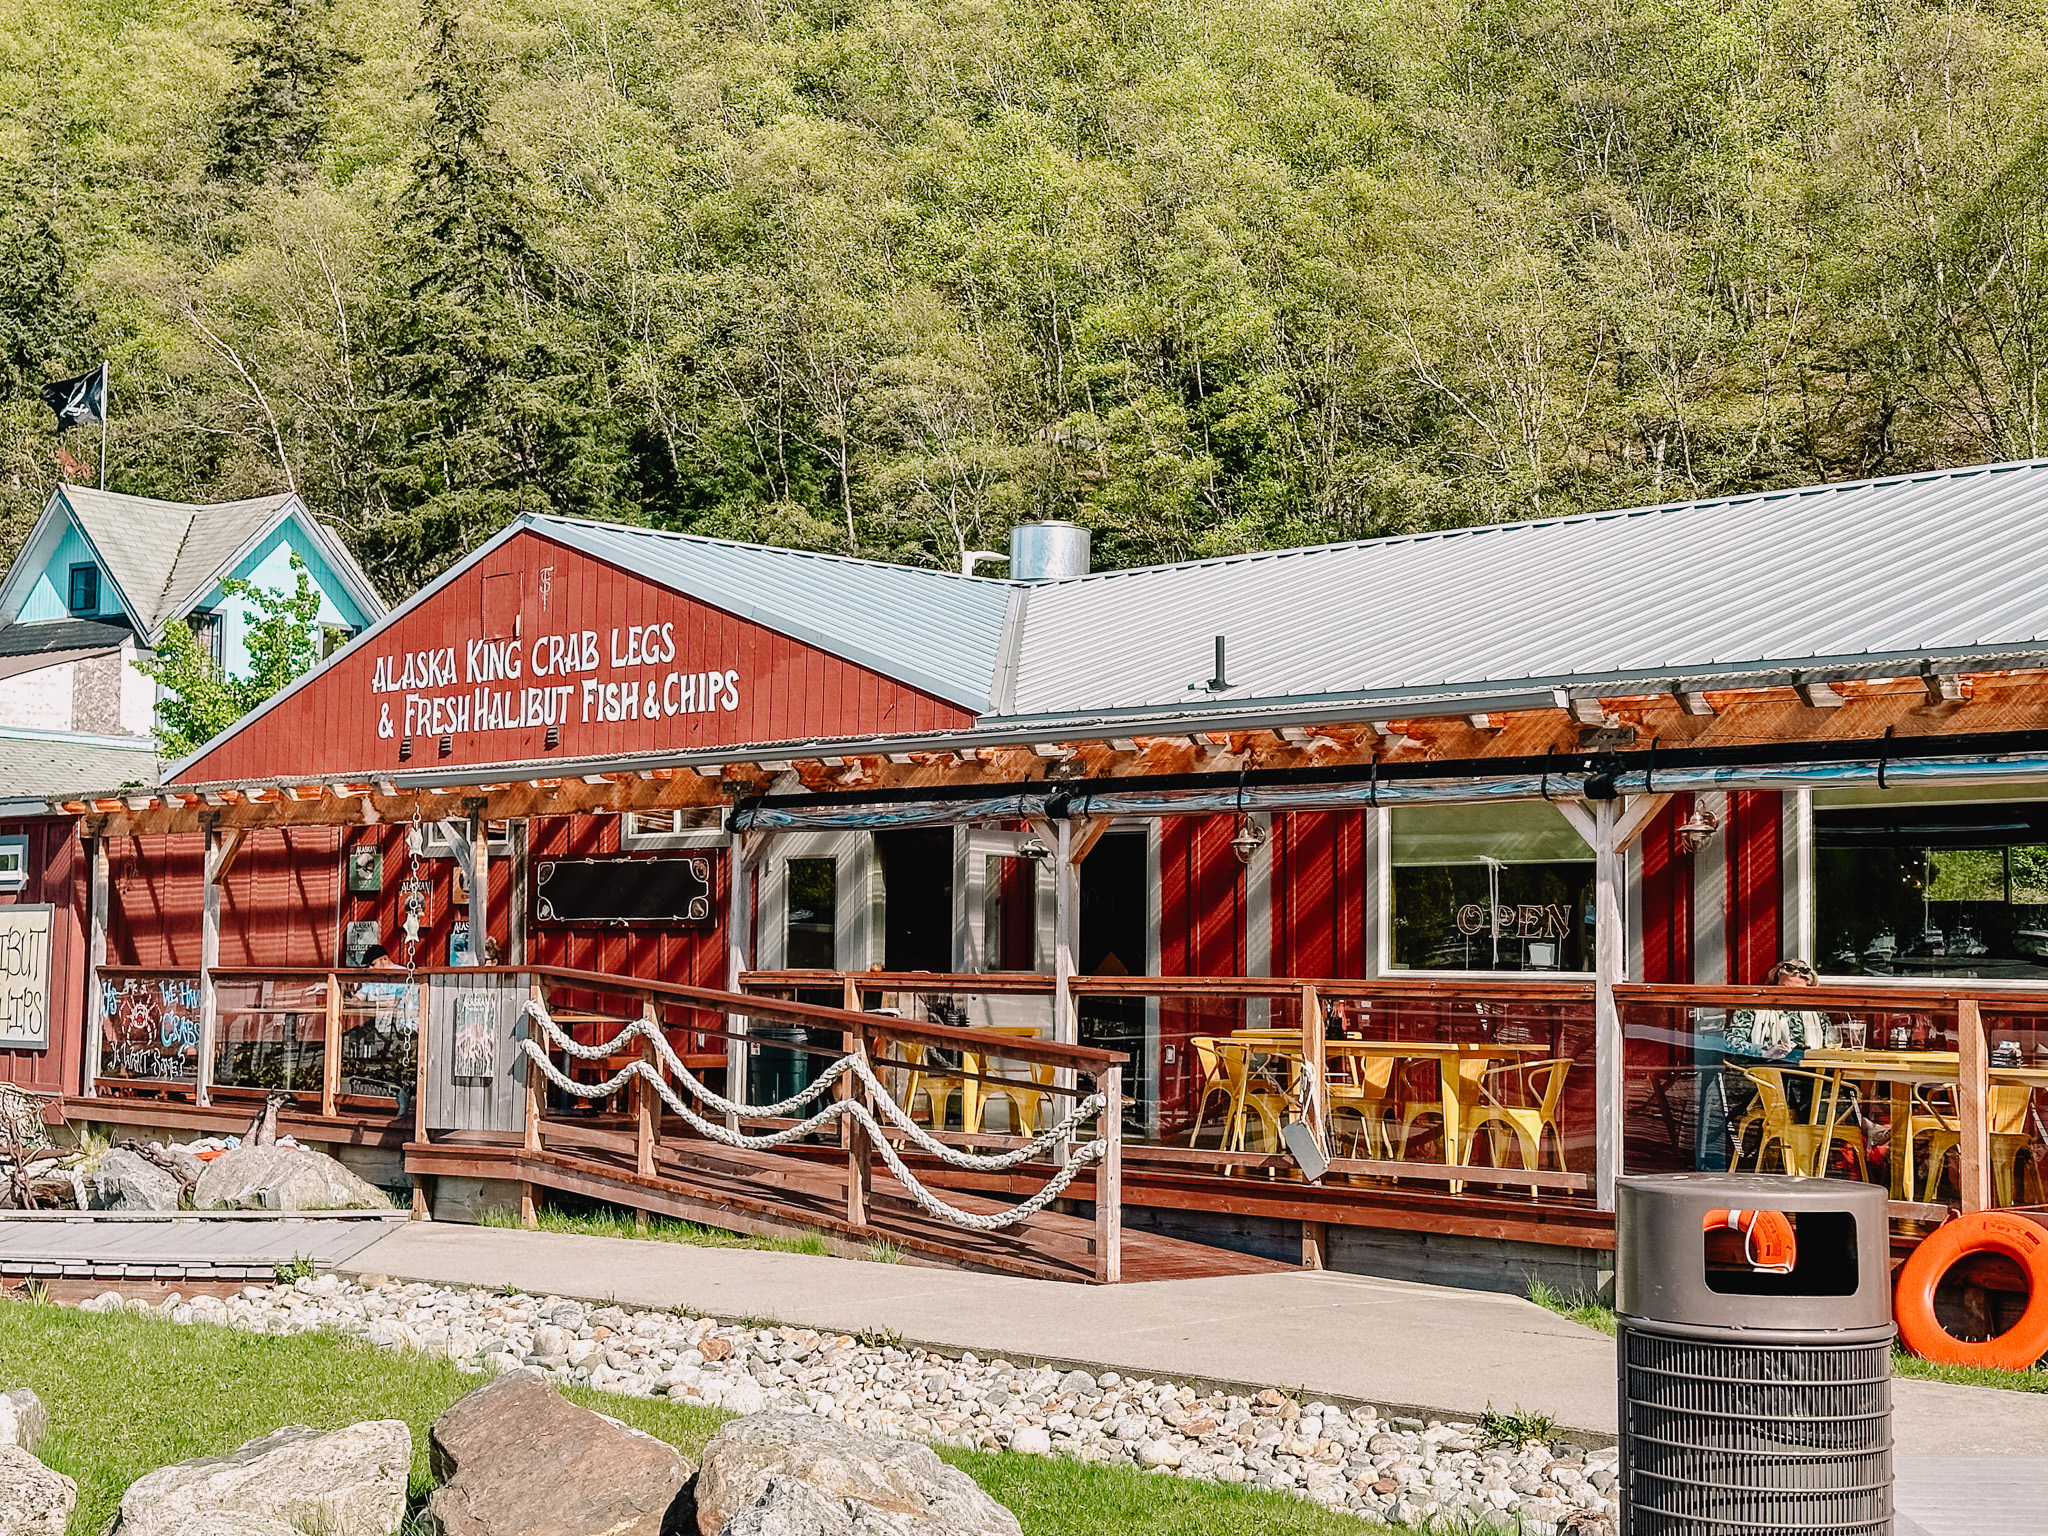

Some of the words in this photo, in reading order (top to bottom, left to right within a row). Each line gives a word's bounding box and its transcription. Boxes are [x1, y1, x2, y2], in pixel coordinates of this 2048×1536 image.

[371, 648, 458, 694] ALASKA
[465, 638, 521, 684] KING
[531, 630, 600, 677] CRAB
[610, 622, 676, 668] LEGS
[377, 702, 395, 739] &
[404, 691, 470, 738] FRESH
[473, 686, 574, 732] HALIBUT
[581, 677, 639, 723] FISH
[643, 682, 661, 721] &
[663, 670, 740, 718] CHIPS
[1456, 904, 1572, 939] OPEN
